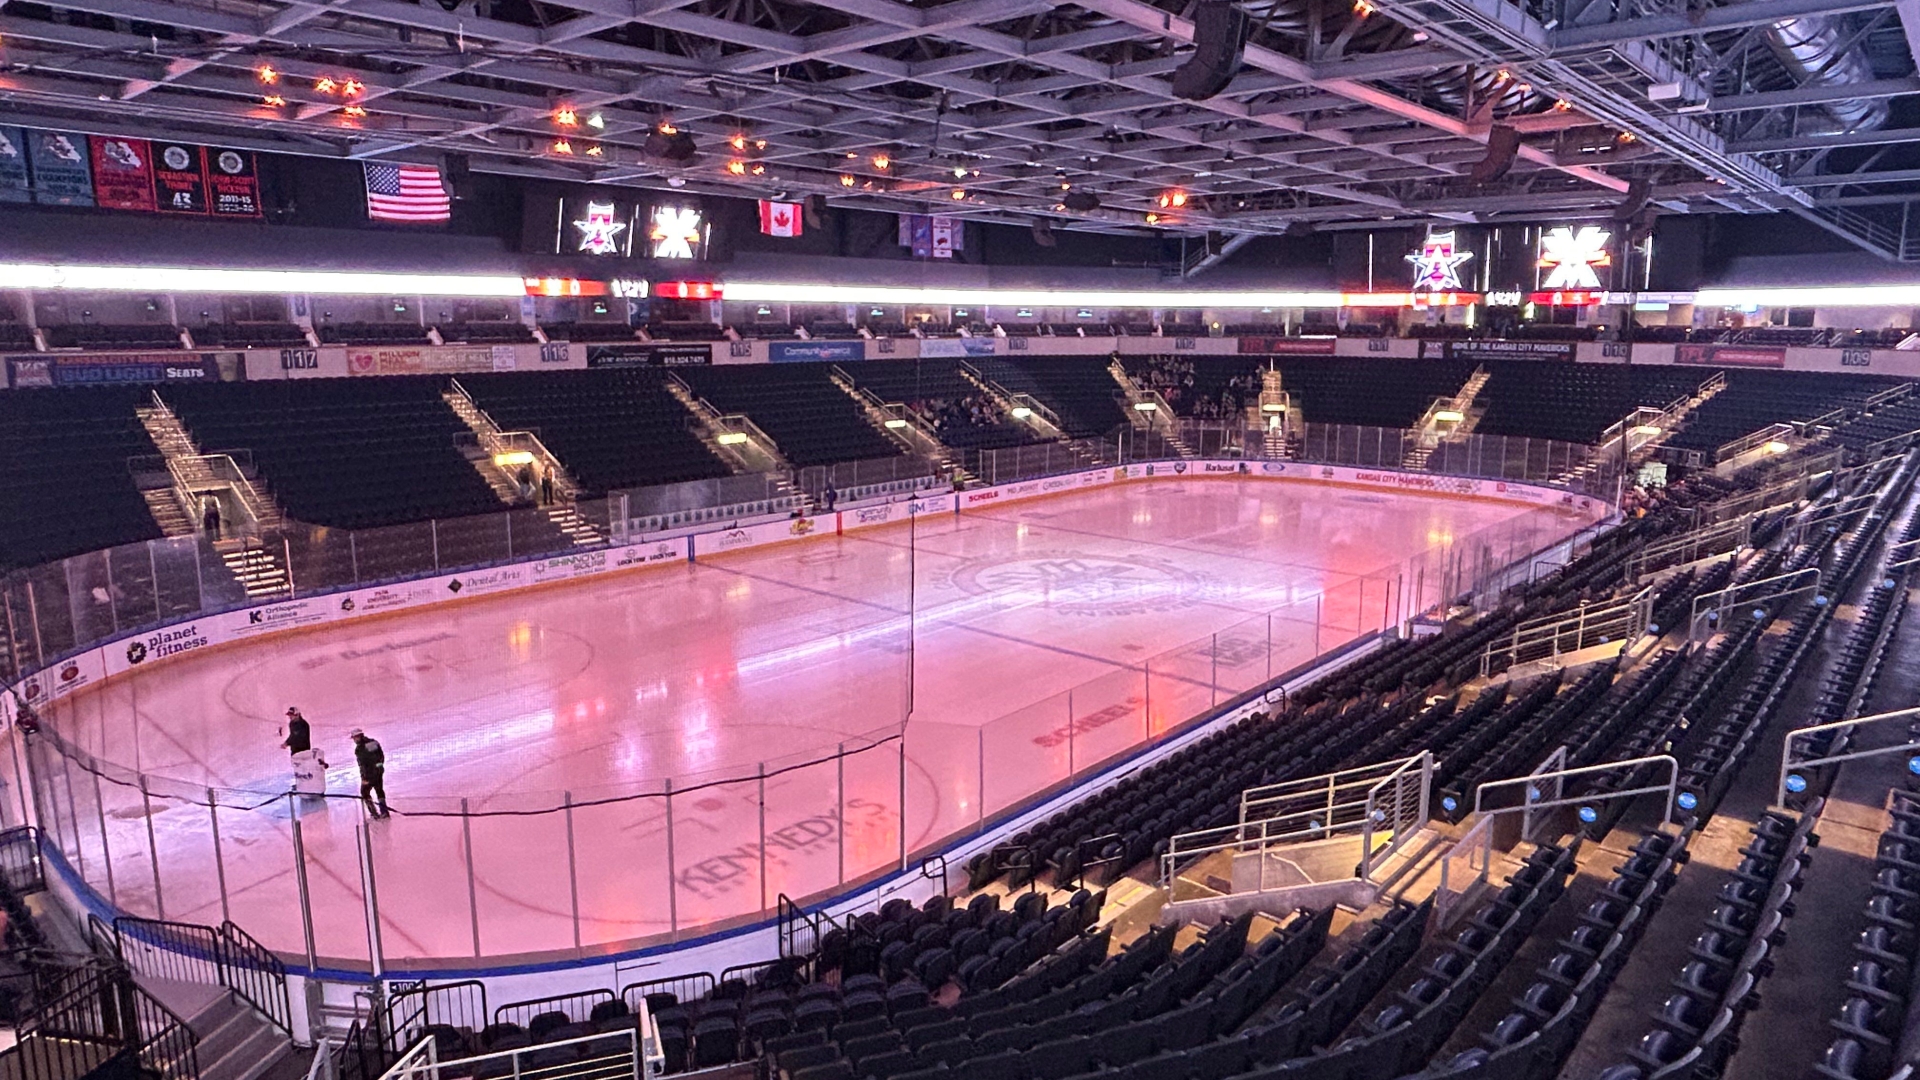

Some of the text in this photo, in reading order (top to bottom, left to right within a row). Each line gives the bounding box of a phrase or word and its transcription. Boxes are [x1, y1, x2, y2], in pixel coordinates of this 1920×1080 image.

[281, 350, 318, 368] 117
[1843, 350, 1870, 366] 109
[148, 625, 197, 651] planet
[156, 636, 208, 657] fitness
